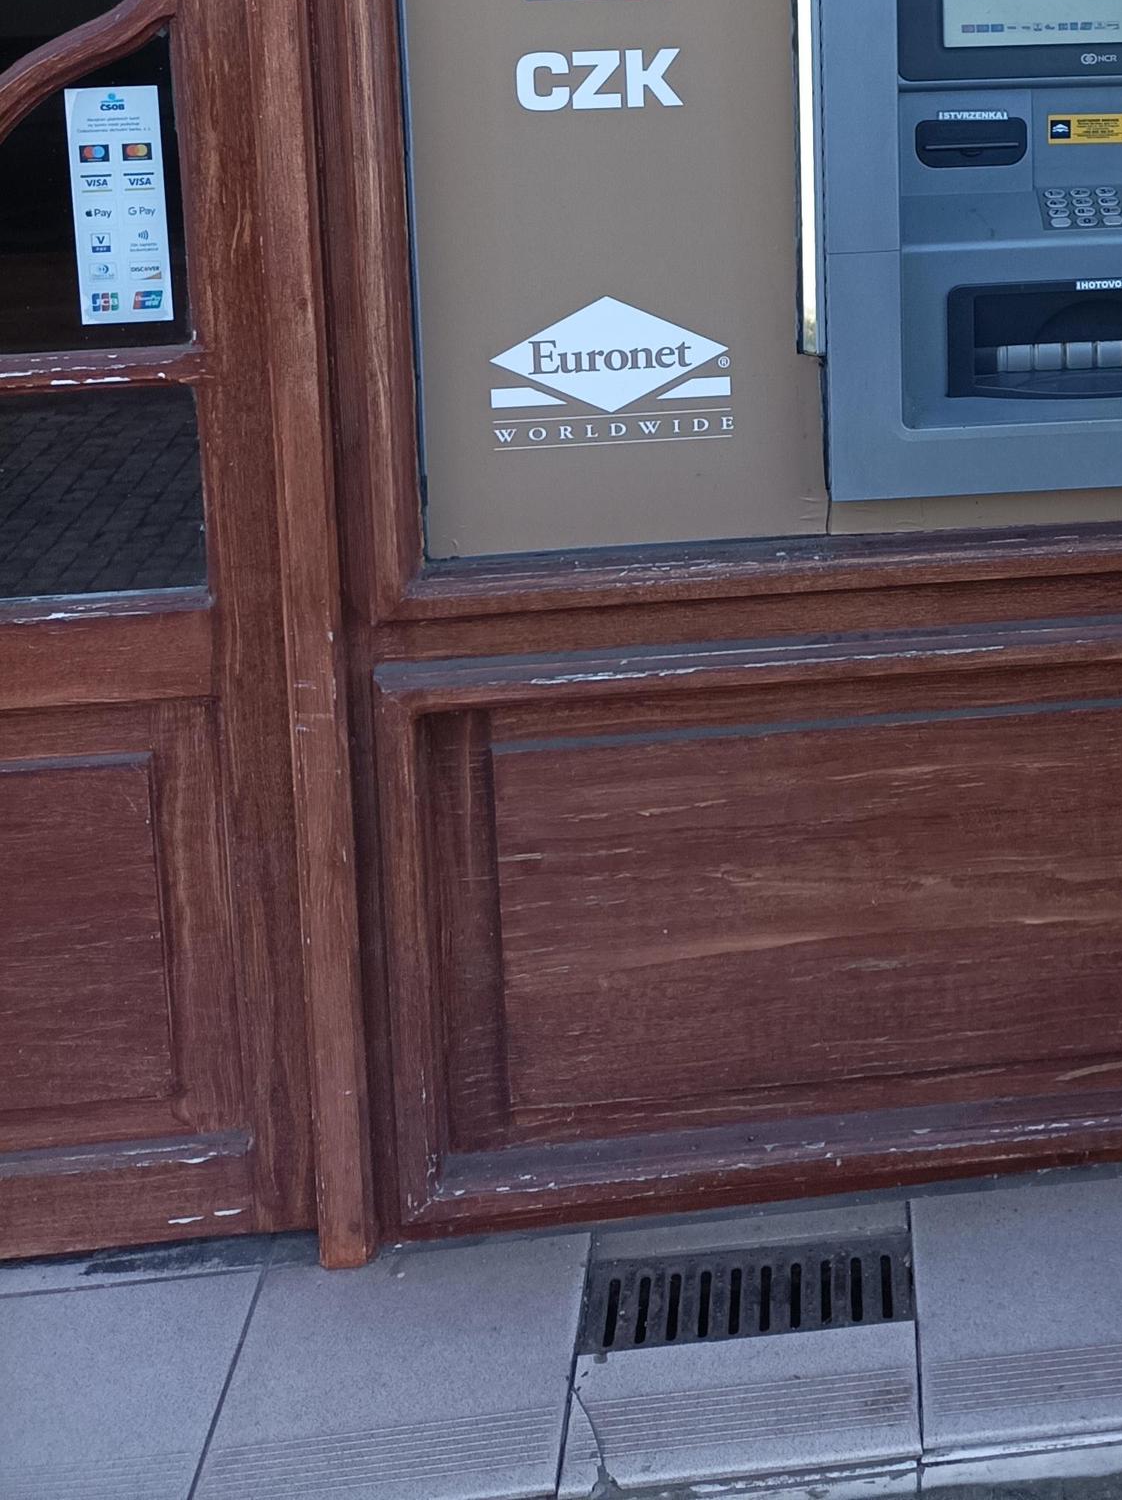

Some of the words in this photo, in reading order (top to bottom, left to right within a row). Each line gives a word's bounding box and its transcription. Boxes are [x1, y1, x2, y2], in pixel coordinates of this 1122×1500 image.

[1098, 54, 1117, 62] NCR
[516, 48, 683, 111] CZK
[943, 111, 1002, 120] STVRZENKA
[86, 179, 108, 187] VISA
[129, 177, 152, 186] VISA
[94, 208, 112, 218] Pay
[139, 206, 156, 217] Pay
[130, 265, 160, 273] DISCOVER
[528, 340, 692, 375] Euronet
[494, 417, 734, 443] WORLDWIDE
